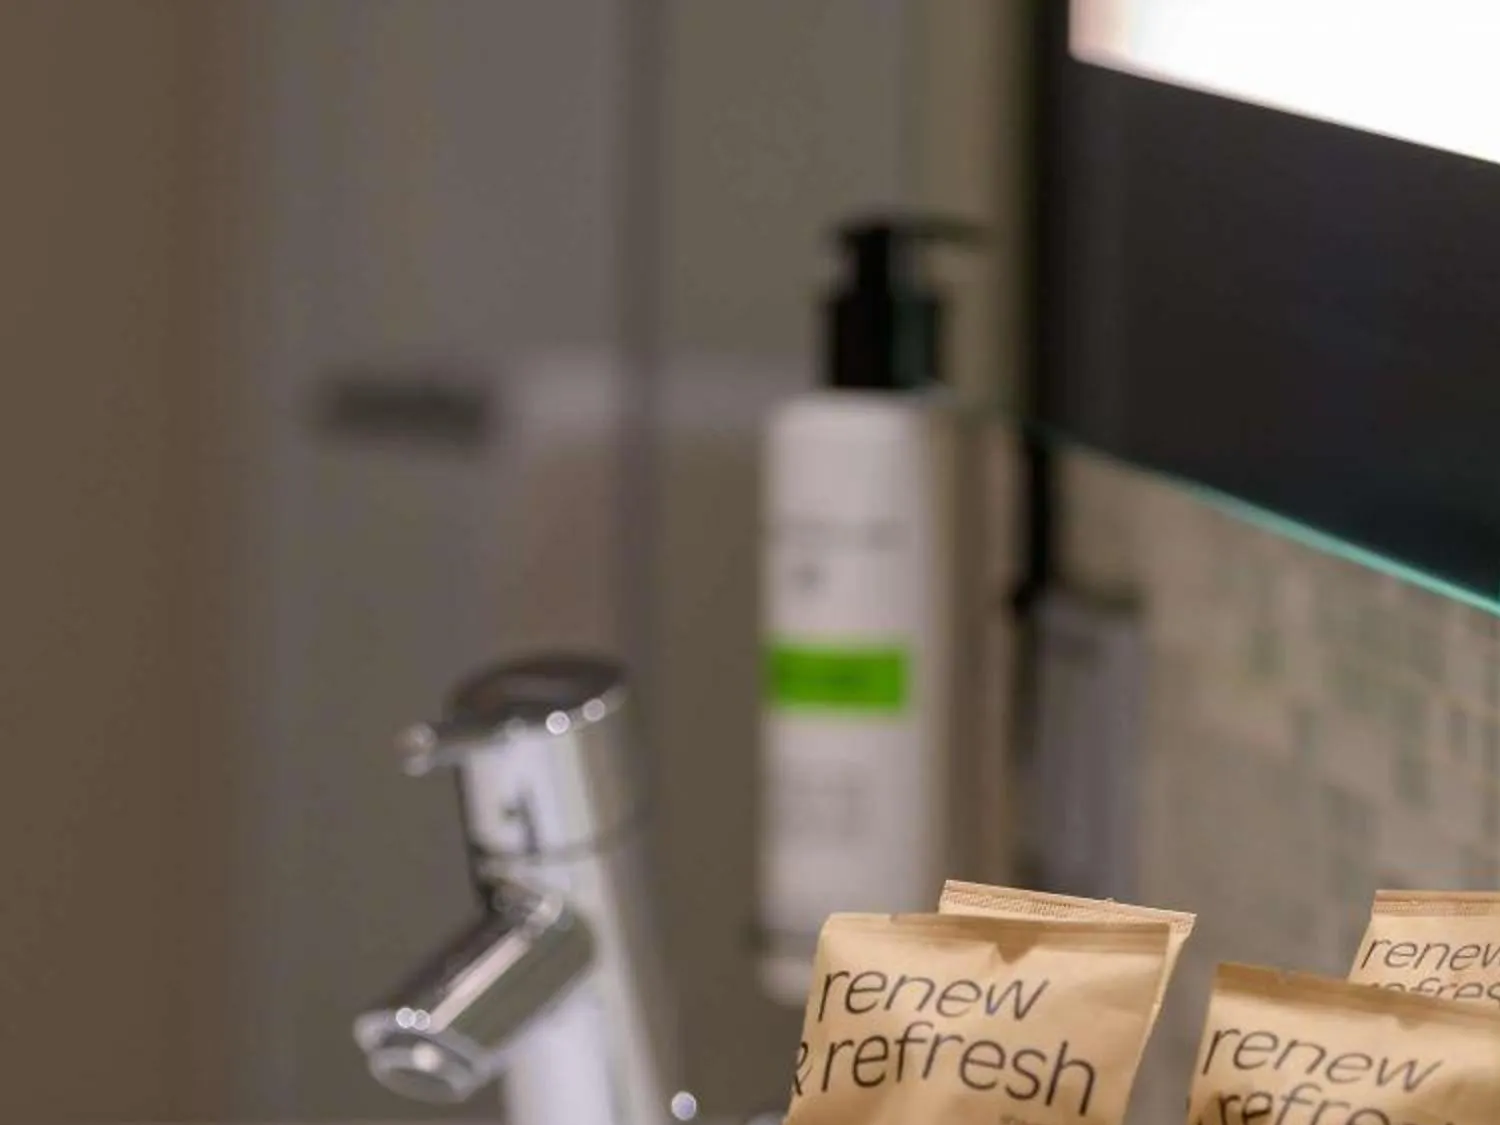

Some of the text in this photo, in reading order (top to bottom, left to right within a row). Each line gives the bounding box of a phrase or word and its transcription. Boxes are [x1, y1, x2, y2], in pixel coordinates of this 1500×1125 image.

[816, 968, 1050, 1023] renew
[821, 1019, 1096, 1117] refresh
[1201, 1027, 1445, 1094] renew
